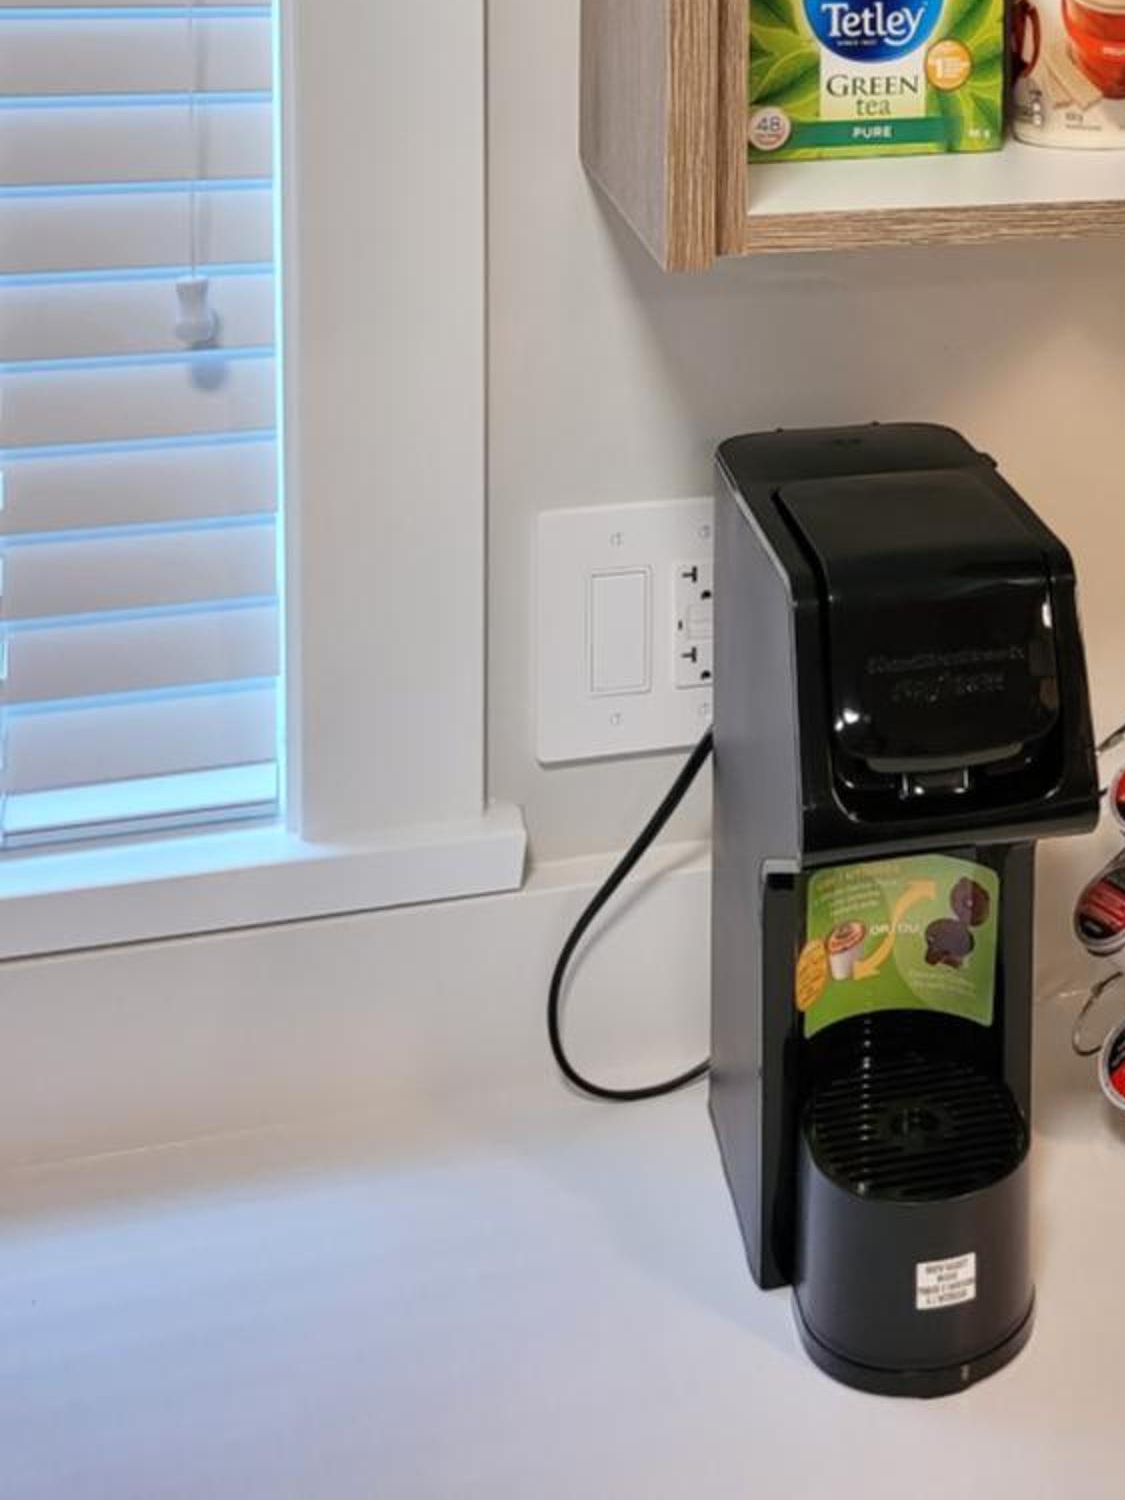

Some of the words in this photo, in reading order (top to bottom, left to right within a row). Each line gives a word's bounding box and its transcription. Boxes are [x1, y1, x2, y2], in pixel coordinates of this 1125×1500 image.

[821, 1, 925, 46] Tetley
[826, 74, 920, 96] GREEN
[856, 100, 891, 116] tea
[756, 116, 781, 132] 48
[852, 125, 893, 139] PURE
